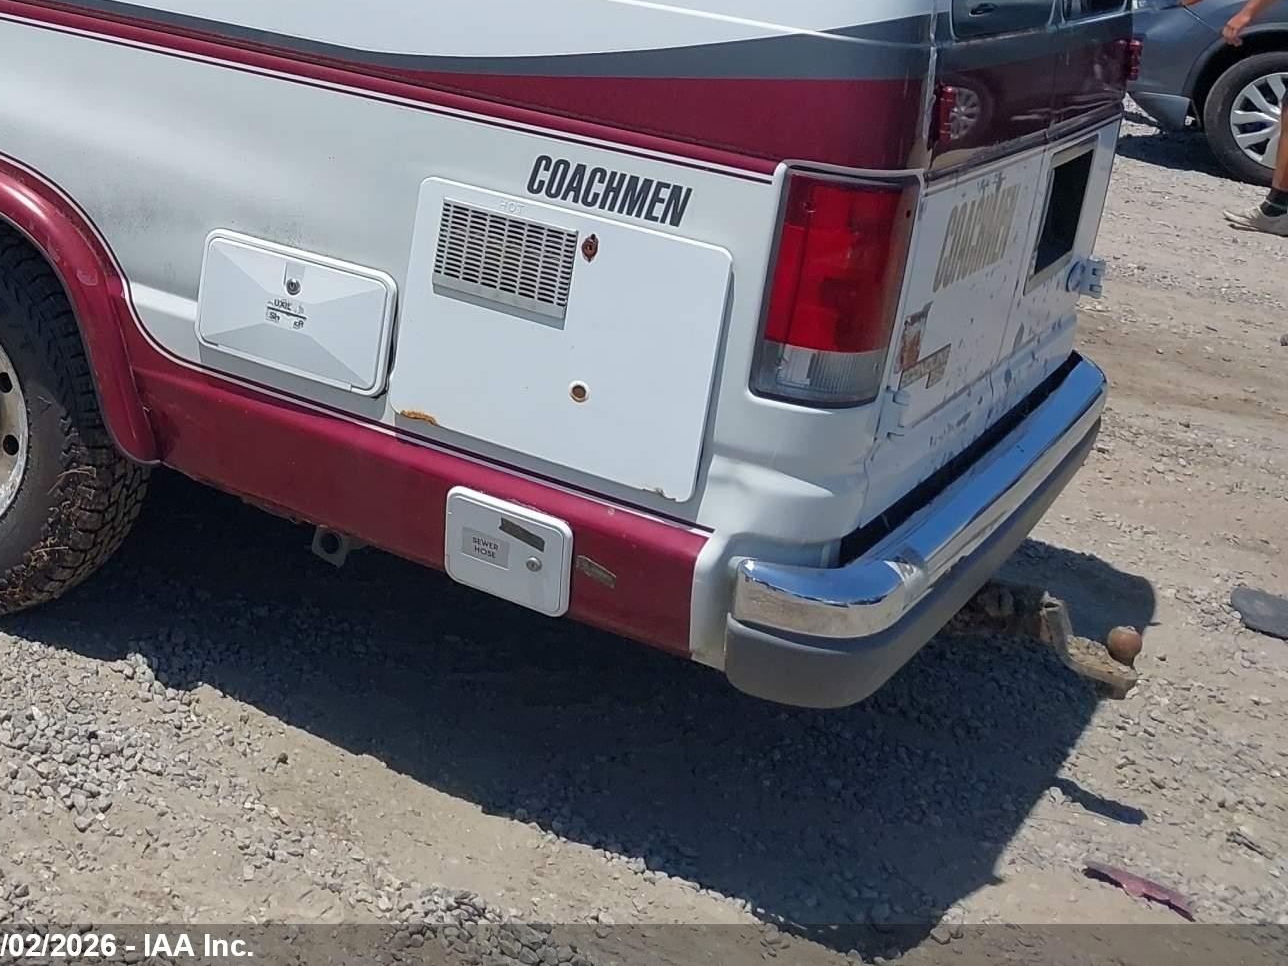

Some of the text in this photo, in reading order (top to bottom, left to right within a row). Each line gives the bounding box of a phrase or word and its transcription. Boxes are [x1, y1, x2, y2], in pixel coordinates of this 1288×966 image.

[526, 154, 694, 228] COACHMEN
[472, 535, 499, 551] SEWER
[474, 545, 497, 559] HOSE
